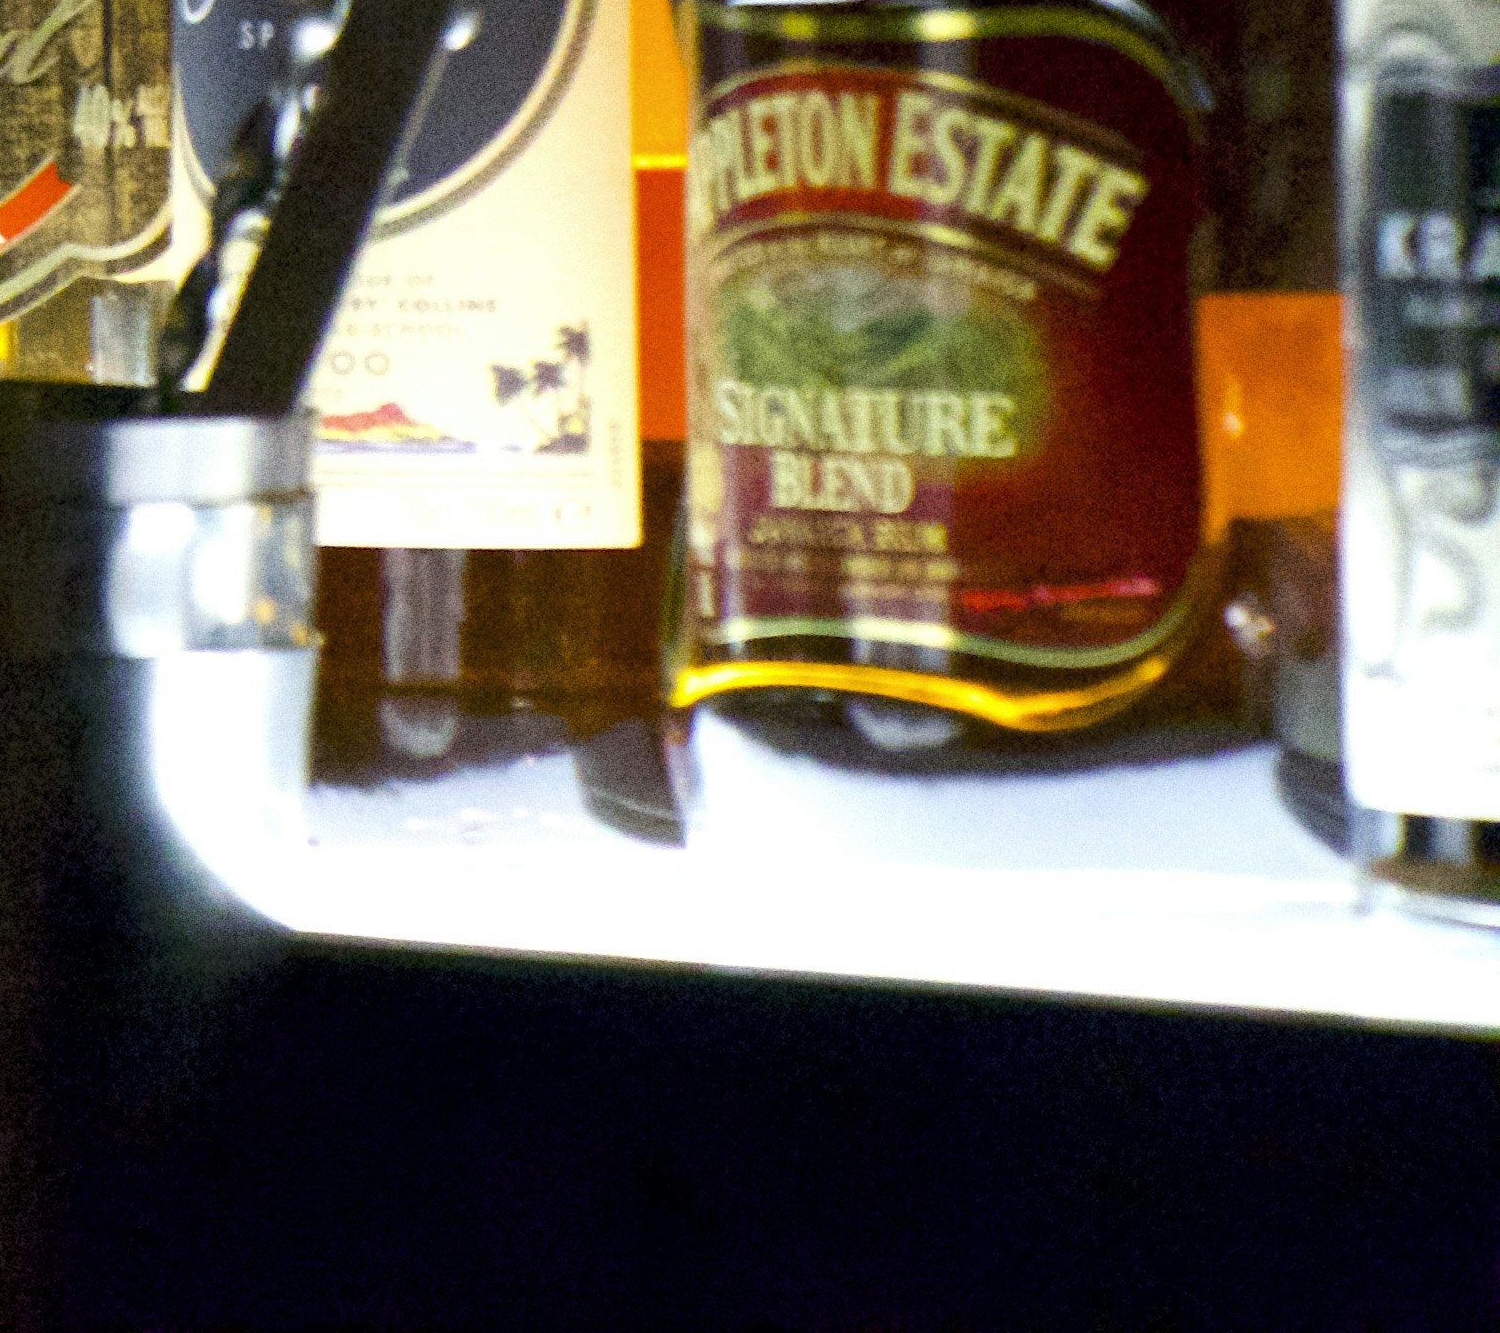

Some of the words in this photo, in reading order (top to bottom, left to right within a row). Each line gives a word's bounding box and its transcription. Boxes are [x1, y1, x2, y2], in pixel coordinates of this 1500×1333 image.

[888, 88, 1152, 275] ESTATE
[715, 379, 1019, 460] SIGNATURE
[770, 448, 918, 516] BLEND
